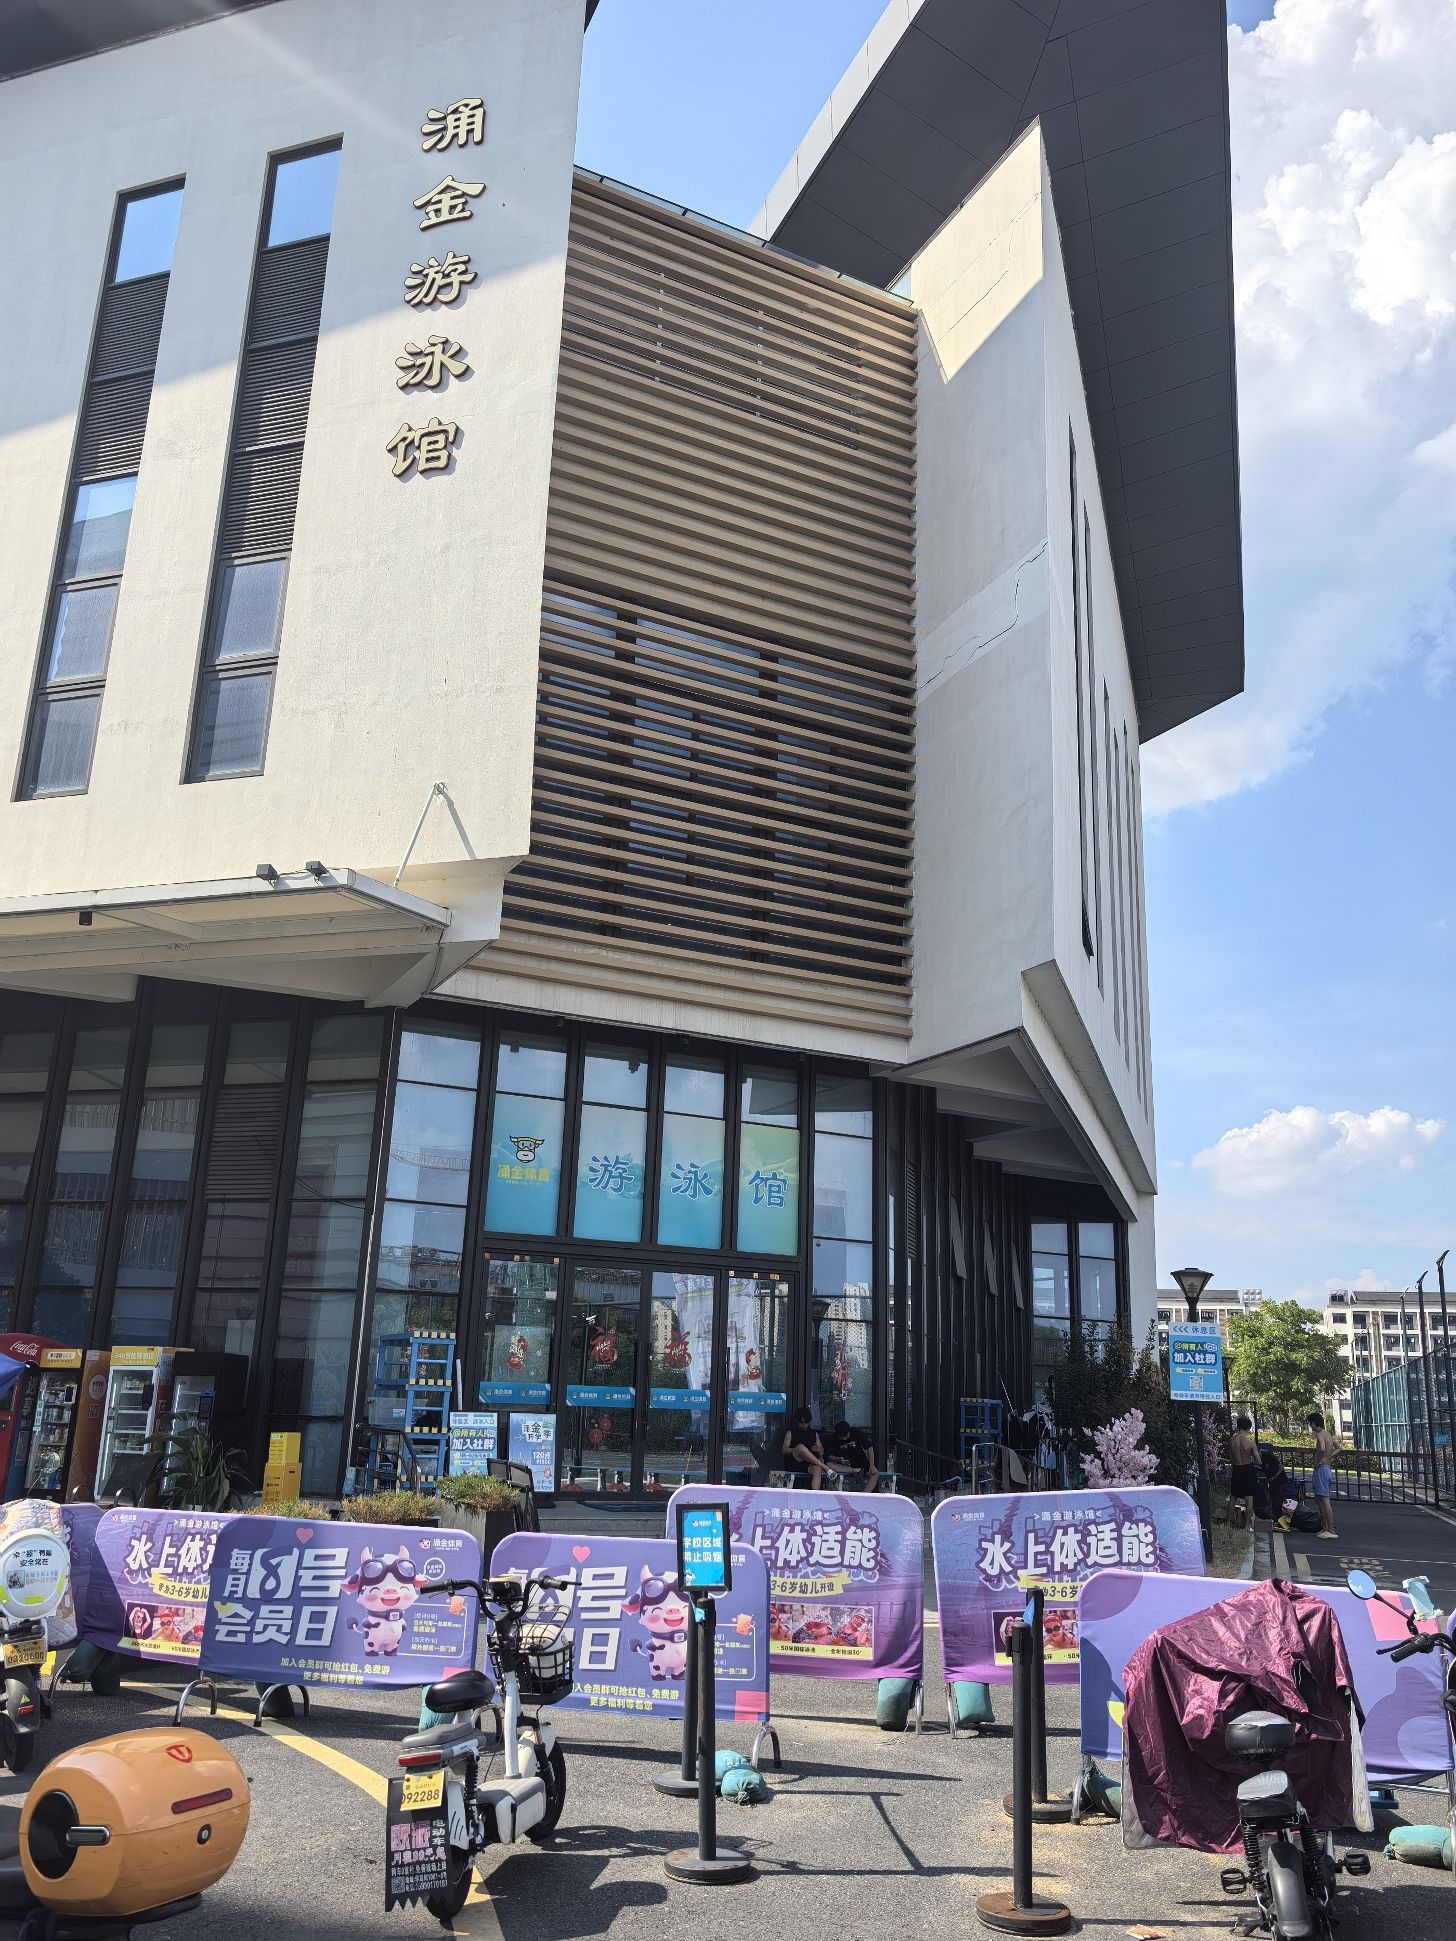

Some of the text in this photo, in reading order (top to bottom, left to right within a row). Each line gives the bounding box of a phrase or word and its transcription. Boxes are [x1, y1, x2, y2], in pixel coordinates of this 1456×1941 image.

[387, 97, 487, 478] 涌金游泳馆
[497, 1164, 549, 1182] 涌金体育
[588, 1155, 788, 1208] 游泳馆
[1192, 1326, 1216, 1334] 休息区
[1174, 1352, 1216, 1364] 加入社群
[452, 1439, 494, 1450] 加入社群
[771, 1508, 823, 1520] 涌金游泳馆
[1041, 1510, 1095, 1522] 涌金游泳馆
[683, 1537, 722, 1549] 学校区域
[731, 1525, 877, 1568] 上体适能
[979, 1521, 1154, 1576] 水上体适能
[683, 1551, 723, 1563] 禁止吸烟
[214, 1602, 338, 1647] 会员日
[281, 1657, 390, 1675] 加入会员群可抢红包、免费游
[303, 1672, 364, 1685] 更多福利等着您
[571, 1682, 679, 1701] 入会员群可抢红包、免费游
[590, 1696, 653, 1711] 更多福利等着您
[432, 1819, 445, 1845] 电动车
